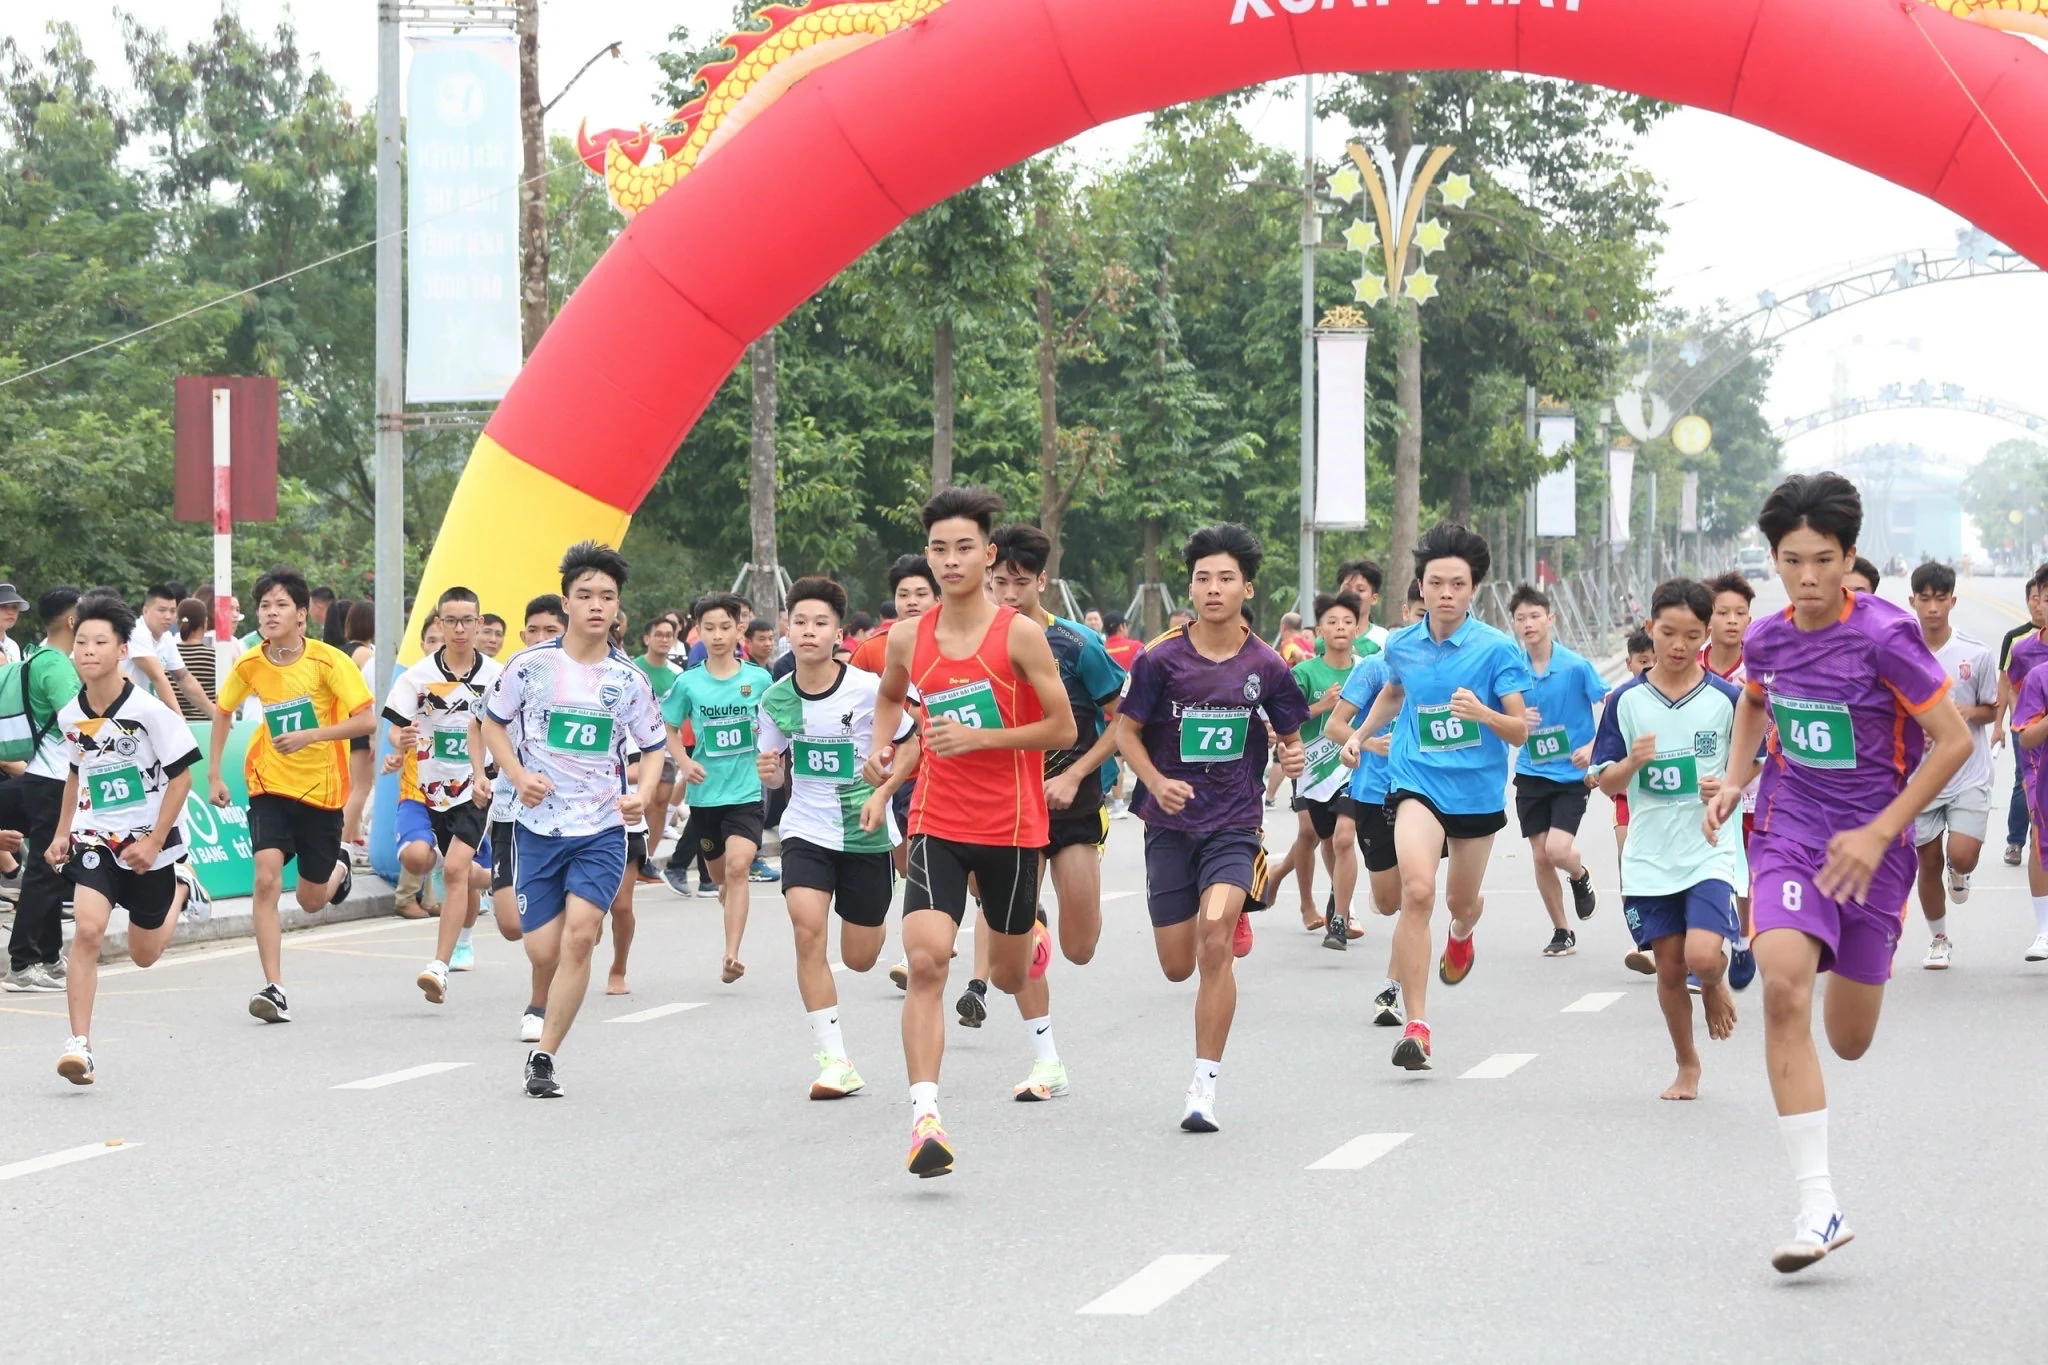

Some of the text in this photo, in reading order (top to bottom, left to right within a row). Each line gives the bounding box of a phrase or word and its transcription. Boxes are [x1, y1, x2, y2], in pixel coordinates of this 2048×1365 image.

[276, 711, 302, 733] 77
[700, 703, 747, 718] Rakuten
[563, 721, 597, 746] 78
[716, 728, 742, 748] 80
[1197, 727, 1232, 751] 73
[1430, 717, 1463, 742] 66
[1790, 719, 1832, 753] 46
[1536, 737, 1560, 757] 69
[808, 750, 840, 773] 85
[100, 777, 131, 803] 26
[1647, 765, 1682, 791] 29
[1782, 881, 1802, 911] 8
